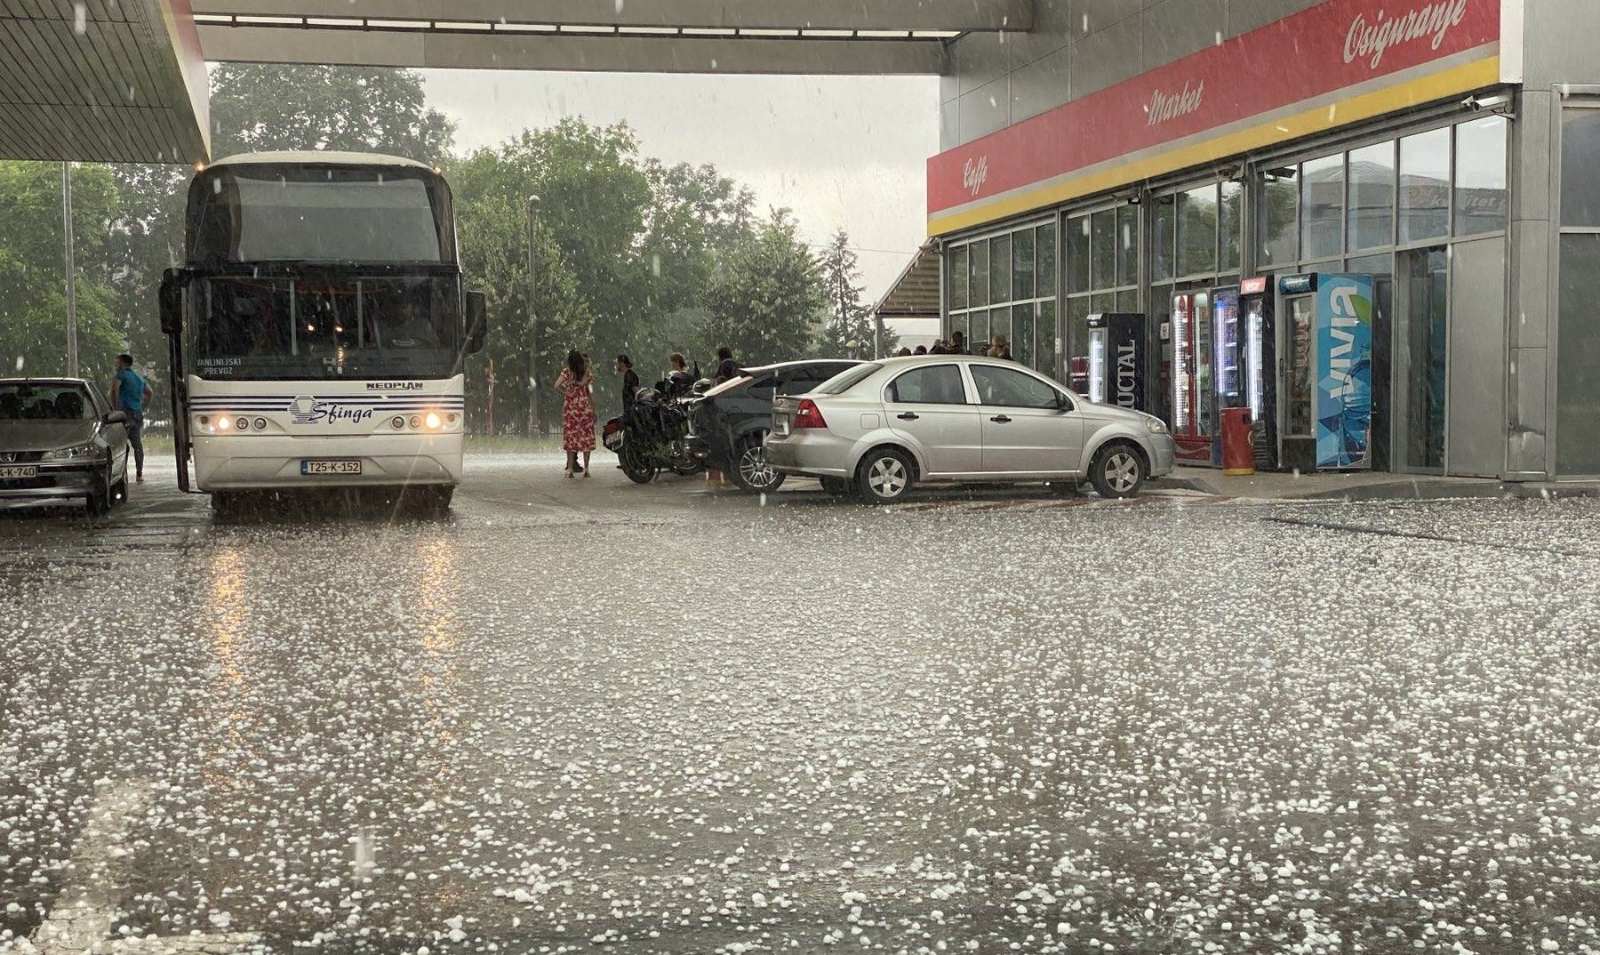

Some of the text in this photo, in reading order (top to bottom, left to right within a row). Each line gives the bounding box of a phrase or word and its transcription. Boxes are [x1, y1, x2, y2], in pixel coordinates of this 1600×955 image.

[1344, 0, 1466, 69] Osiguranje
[1148, 80, 1203, 125] Market
[963, 155, 988, 196] Caffe
[366, 382, 423, 390] NEOPLAN
[1117, 338, 1136, 408] UCTAL
[308, 402, 373, 424] Sfinga
[310, 462, 359, 472] T25-K-152
